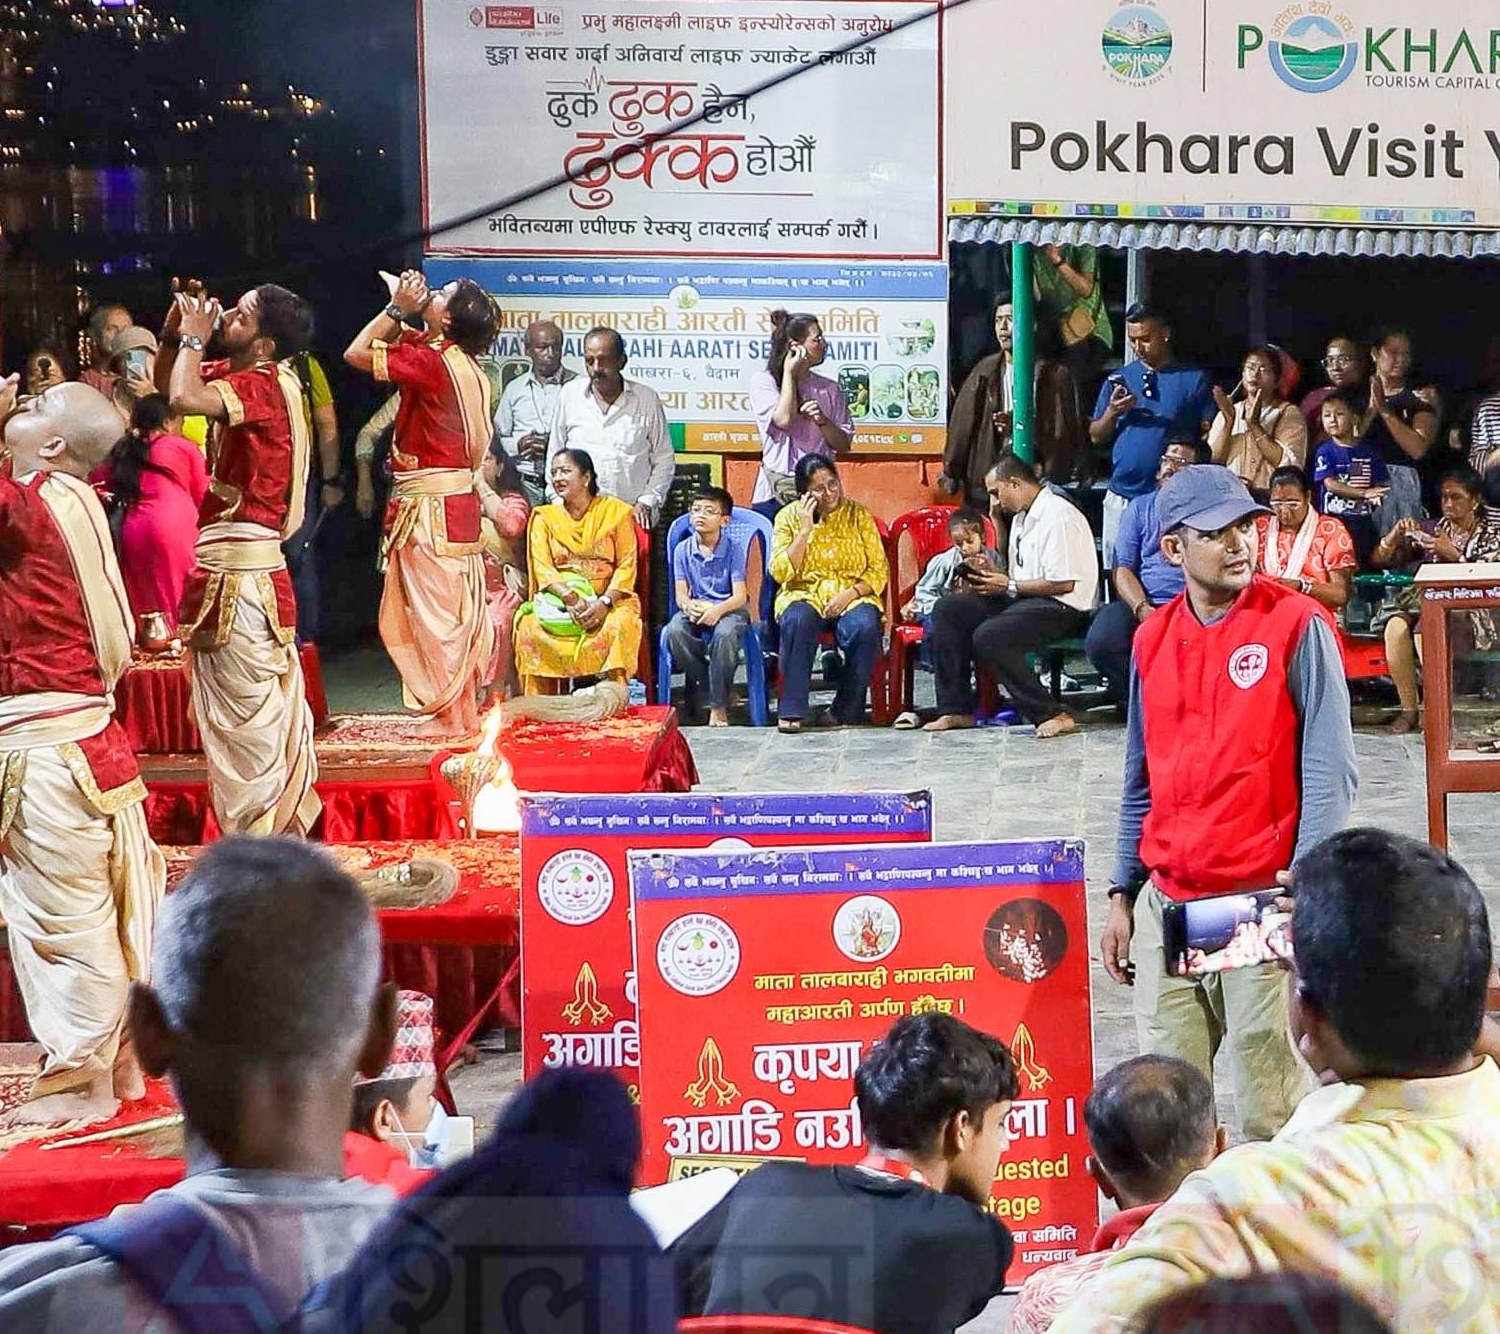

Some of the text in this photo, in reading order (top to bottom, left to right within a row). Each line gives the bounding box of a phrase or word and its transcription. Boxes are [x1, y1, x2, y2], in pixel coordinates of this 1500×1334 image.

[537, 13, 560, 26] Life
[582, 14, 607, 33] प्रभु
[612, 11, 681, 30] महालक्ष्मी
[687, 15, 731, 31] लाइफ
[525, 46, 568, 62] सवार
[575, 43, 609, 63] गर्दा
[615, 43, 684, 64] अनिवार्य
[691, 49, 741, 65] लाइफ
[749, 46, 810, 66] ज्याकेट
[1109, 52, 1165, 65] POKHARA
[1128, 79, 1147, 88] YEAR
[1365, 74, 1431, 89] TOURISM
[1434, 75, 1492, 90] CAPITAL
[1010, 120, 1295, 175] Pokhara
[1317, 124, 1464, 180] Visit
[579, 215, 636, 237] एपीएफ
[776, 218, 833, 240] सम्पर्क
[676, 306, 747, 333] आरती
[494, 338, 528, 357] MAT
[562, 339, 662, 359] ALRAHI
[669, 339, 743, 360] AARATI
[824, 341, 879, 361] AMITI
[754, 963, 975, 991] माता तालबाराही भगवतीमा
[766, 998, 853, 1025] महाआरती
[859, 997, 904, 1018] अर्पण
[542, 1019, 640, 1069] अगाडि
[753, 1041, 863, 1095] कृपया
[663, 1098, 784, 1156] अगाडि
[993, 1153, 1069, 1181] uested
[984, 1195, 1041, 1221] tage
[1032, 1225, 1078, 1243] समिति
